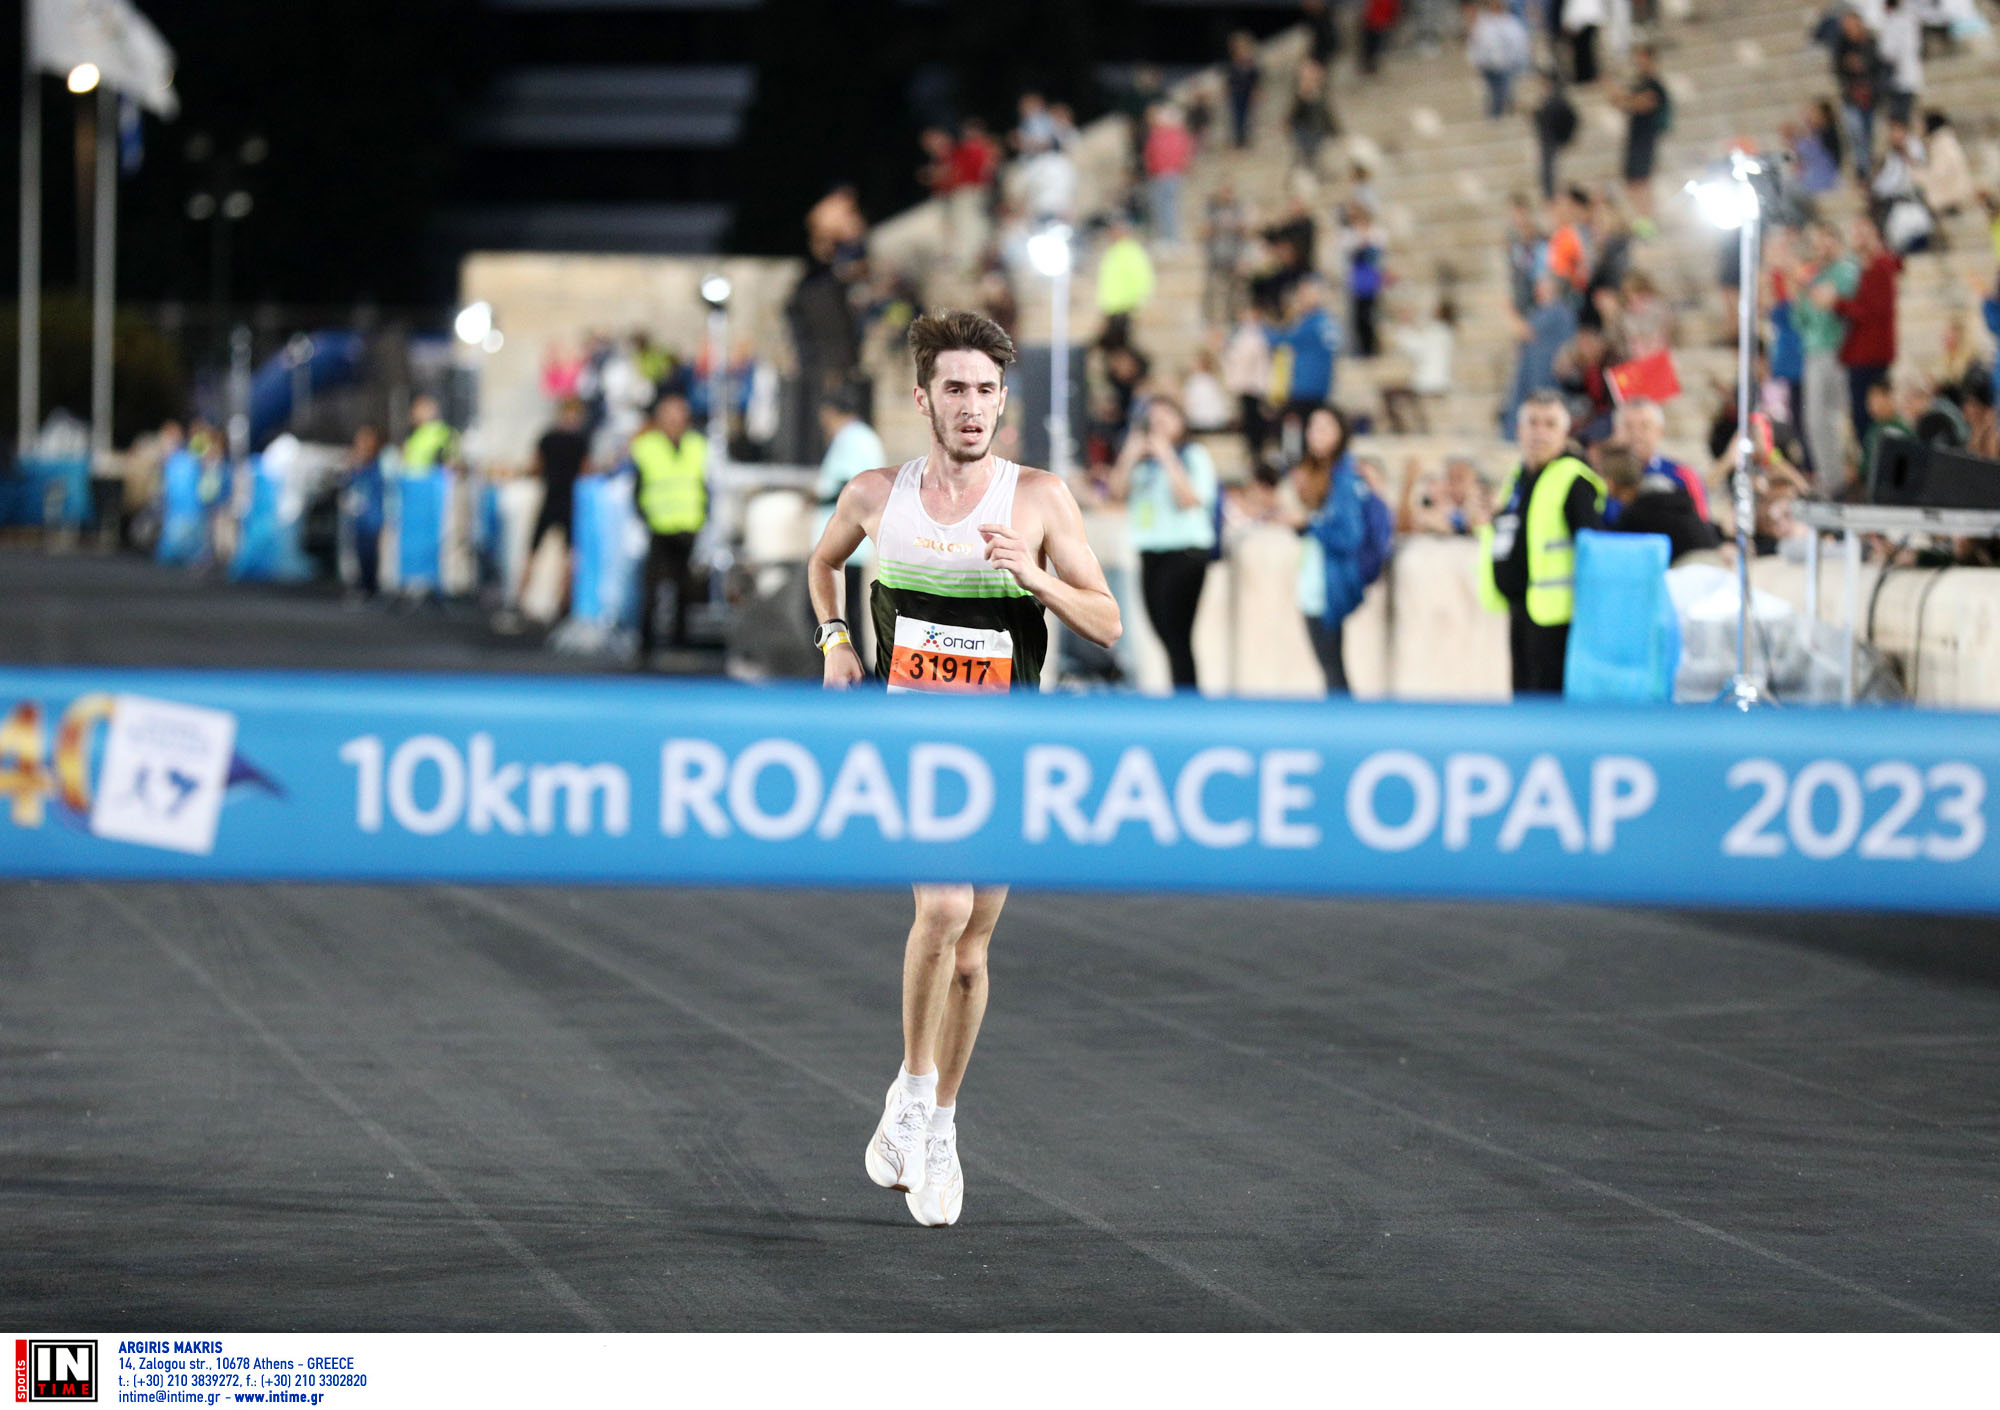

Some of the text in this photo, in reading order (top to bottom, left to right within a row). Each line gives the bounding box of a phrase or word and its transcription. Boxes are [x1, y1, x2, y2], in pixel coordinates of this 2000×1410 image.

[910, 653, 991, 685] 31917
[339, 731, 630, 837] 10km
[660, 738, 996, 843] ROAD
[1021, 743, 1322, 850] RACE
[1345, 750, 1659, 854] OPAP
[1720, 758, 1987, 862] 2023
